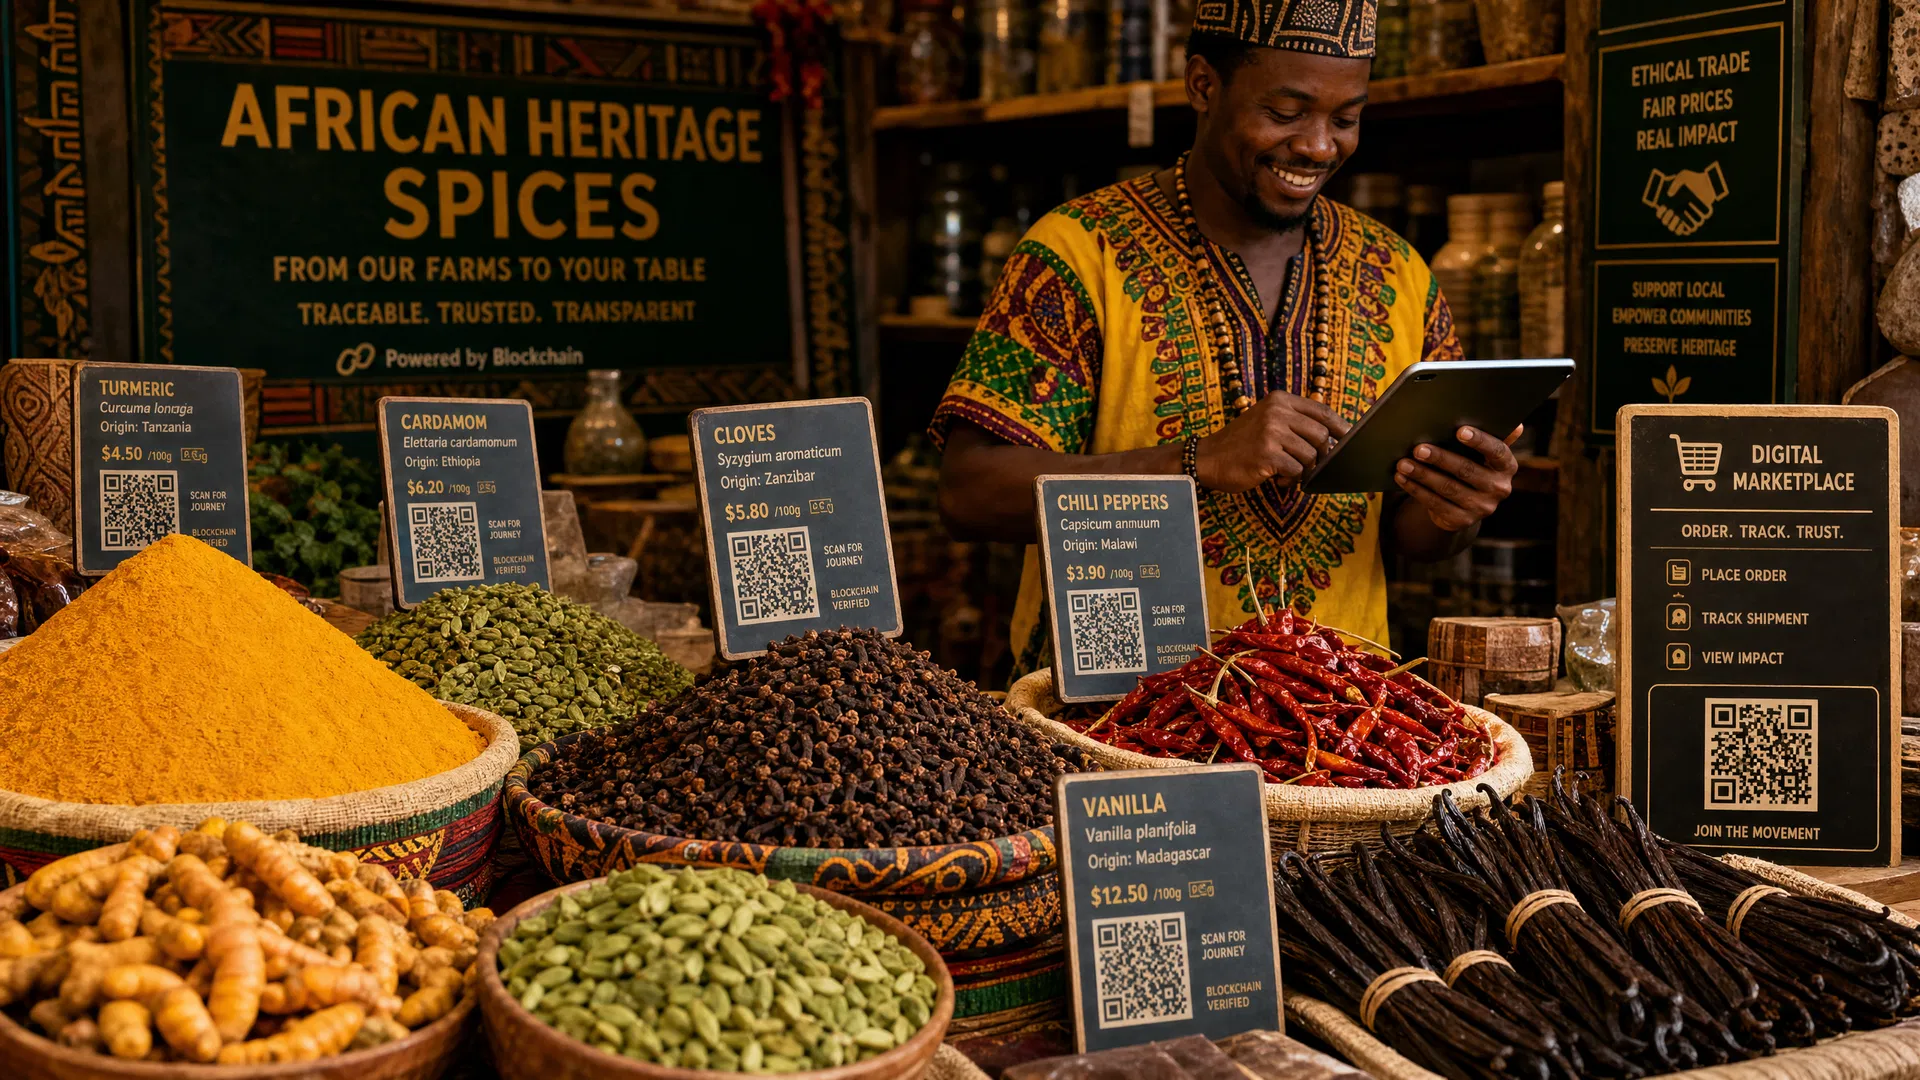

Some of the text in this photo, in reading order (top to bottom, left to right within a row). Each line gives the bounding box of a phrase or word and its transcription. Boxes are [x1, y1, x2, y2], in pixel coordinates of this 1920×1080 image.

[1631, 51, 1750, 86] ETHICAL TRADE
[1642, 88, 1733, 118] FAIR PRICES
[221, 84, 761, 161] AFRICAN HERITAGE
[1636, 121, 1738, 150] REAL IMPACT
[384, 168, 658, 240] SPICES
[274, 256, 705, 281] FROM OUR FARMS TO YOUR TABLE
[1632, 282, 1725, 298] SUPPORT LOCAL
[298, 301, 694, 324] TRACEABLE. TRUSTED. TRANSPARENT
[1612, 308, 1751, 326] EMPOWER COMMUNITIES
[1624, 337, 1736, 356] PRESERVE HERITAGE
[386, 347, 583, 370] Powered by Blockchain
[99, 380, 174, 396] TURMERIC
[100, 421, 191, 435] Origin: Tanzania
[401, 414, 486, 429] CARDAMOM
[714, 424, 775, 444] CLOVES
[403, 437, 517, 448] Elettaria cardamomum
[101, 445, 142, 461] $4.50
[147, 451, 171, 463] /100g
[718, 446, 841, 468] Syzygium aromaticum
[1751, 445, 1822, 463] DIGITAL
[405, 456, 480, 470] Origin: Ethiopia
[407, 479, 444, 496] $6.20
[448, 484, 470, 495] /100g
[720, 470, 815, 491] Origin: Zanzibar
[1733, 472, 1854, 490] MARKETPLACE
[190, 491, 226, 499] SCAN FOR
[1057, 494, 1168, 511] CHILI PEPPERS
[190, 503, 225, 511] JOURNEY
[725, 503, 768, 523] $5.80
[774, 505, 800, 517] /100g
[488, 520, 506, 528] SCAN
[1060, 518, 1111, 533] Capsicum
[1681, 524, 1843, 538] ORDER. TRACK. TRUST.
[190, 528, 236, 538] BLOCKCHAIN
[489, 530, 521, 539] JOURNEY
[824, 543, 862, 554] SCAN FOR
[1062, 538, 1137, 553] Origin: Malawi
[493, 555, 534, 564] BLOCKCHAIN
[825, 555, 862, 567] JOURNEY
[494, 565, 526, 574] VERIFIED
[1066, 565, 1105, 582] $3.90
[1110, 569, 1133, 580] /100g
[1701, 569, 1786, 581] PLACE ORDER
[831, 585, 878, 600] BLOCKCHAIN
[832, 598, 869, 610] VERIFIED
[1152, 605, 1185, 614] SCAN FOR
[1153, 617, 1185, 626] JOURNEY
[1701, 612, 1809, 624] TRACK SHIPMENT
[1157, 655, 1190, 666] VERIFIED
[1701, 652, 1784, 664] VIEW IMPACT
[1082, 793, 1166, 817] VANILLA
[1085, 821, 1196, 842] Vanilla planifolia
[1694, 825, 1820, 840] JOIN THE MOVEMENT
[1088, 848, 1211, 871] Origin: Madagascar
[1090, 884, 1147, 907] $12.50
[1153, 888, 1181, 901] /100g
[1201, 930, 1246, 945] SCAN FOR
[1202, 945, 1245, 960] JOURNEY
[1206, 981, 1261, 999] BLOCKCHAIN
[1207, 997, 1249, 1010] VERIFIED
